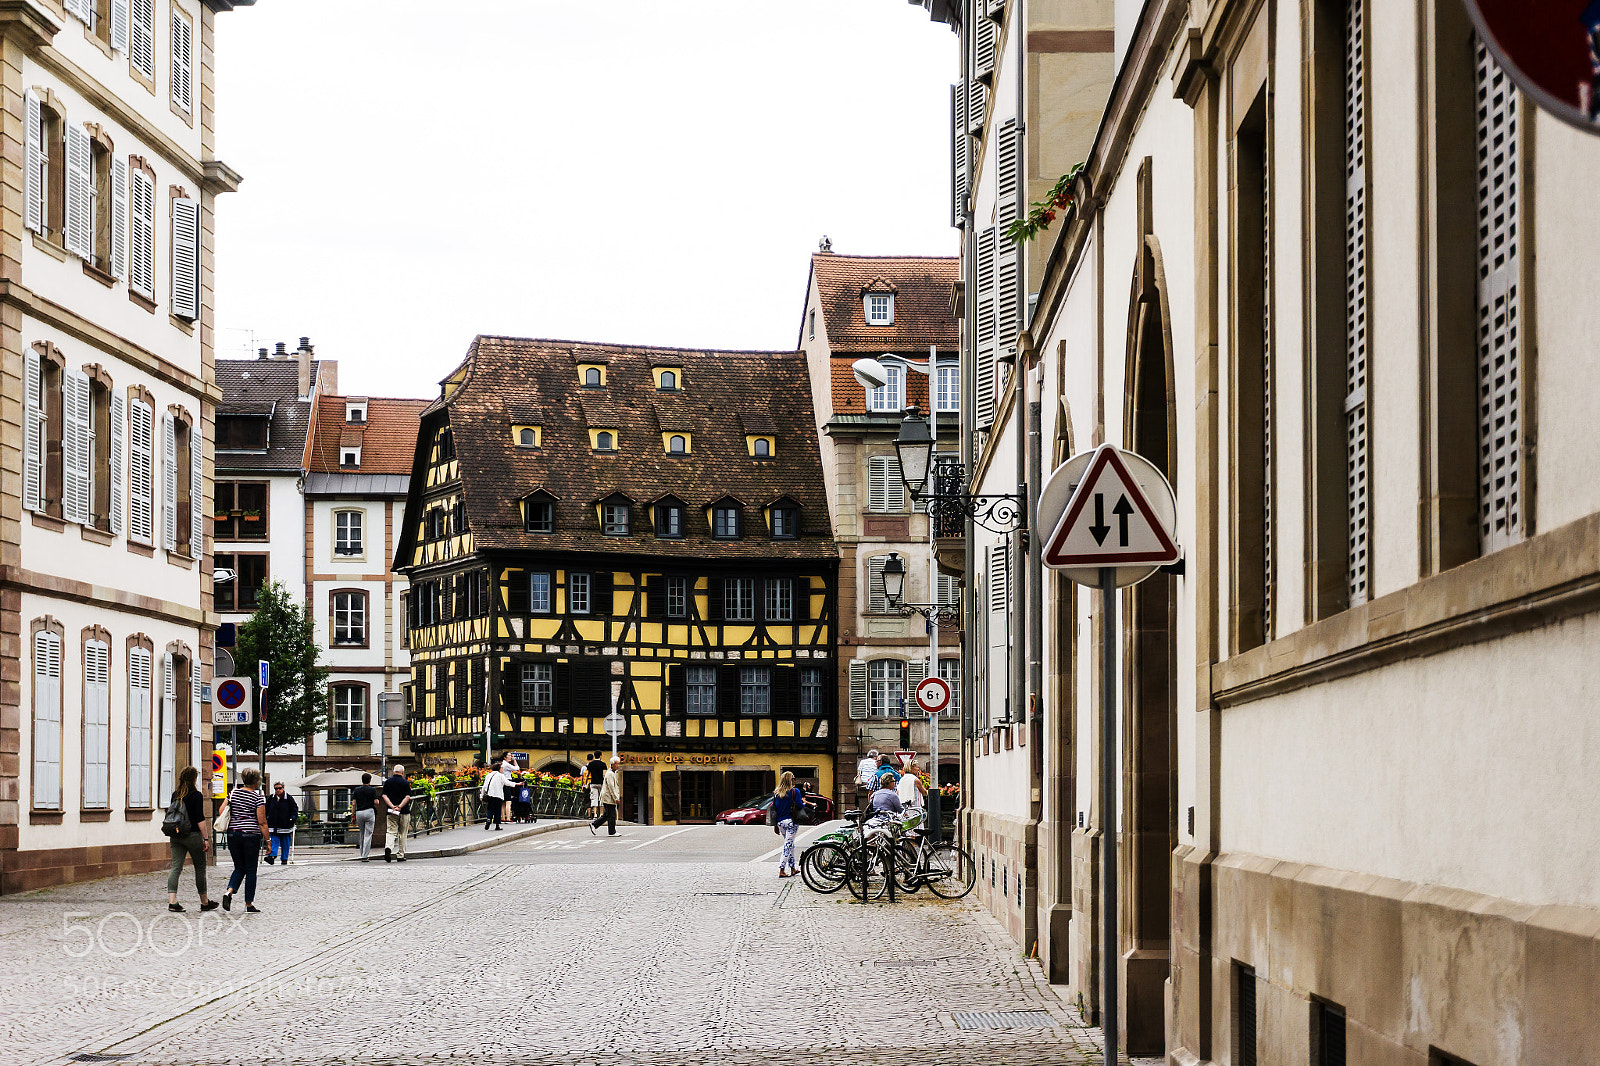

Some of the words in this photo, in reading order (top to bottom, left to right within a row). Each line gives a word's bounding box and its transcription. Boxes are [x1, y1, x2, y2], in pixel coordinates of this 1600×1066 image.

[619, 753, 659, 764] Bistrot
[664, 753, 684, 764] des
[690, 753, 735, 765] copains
